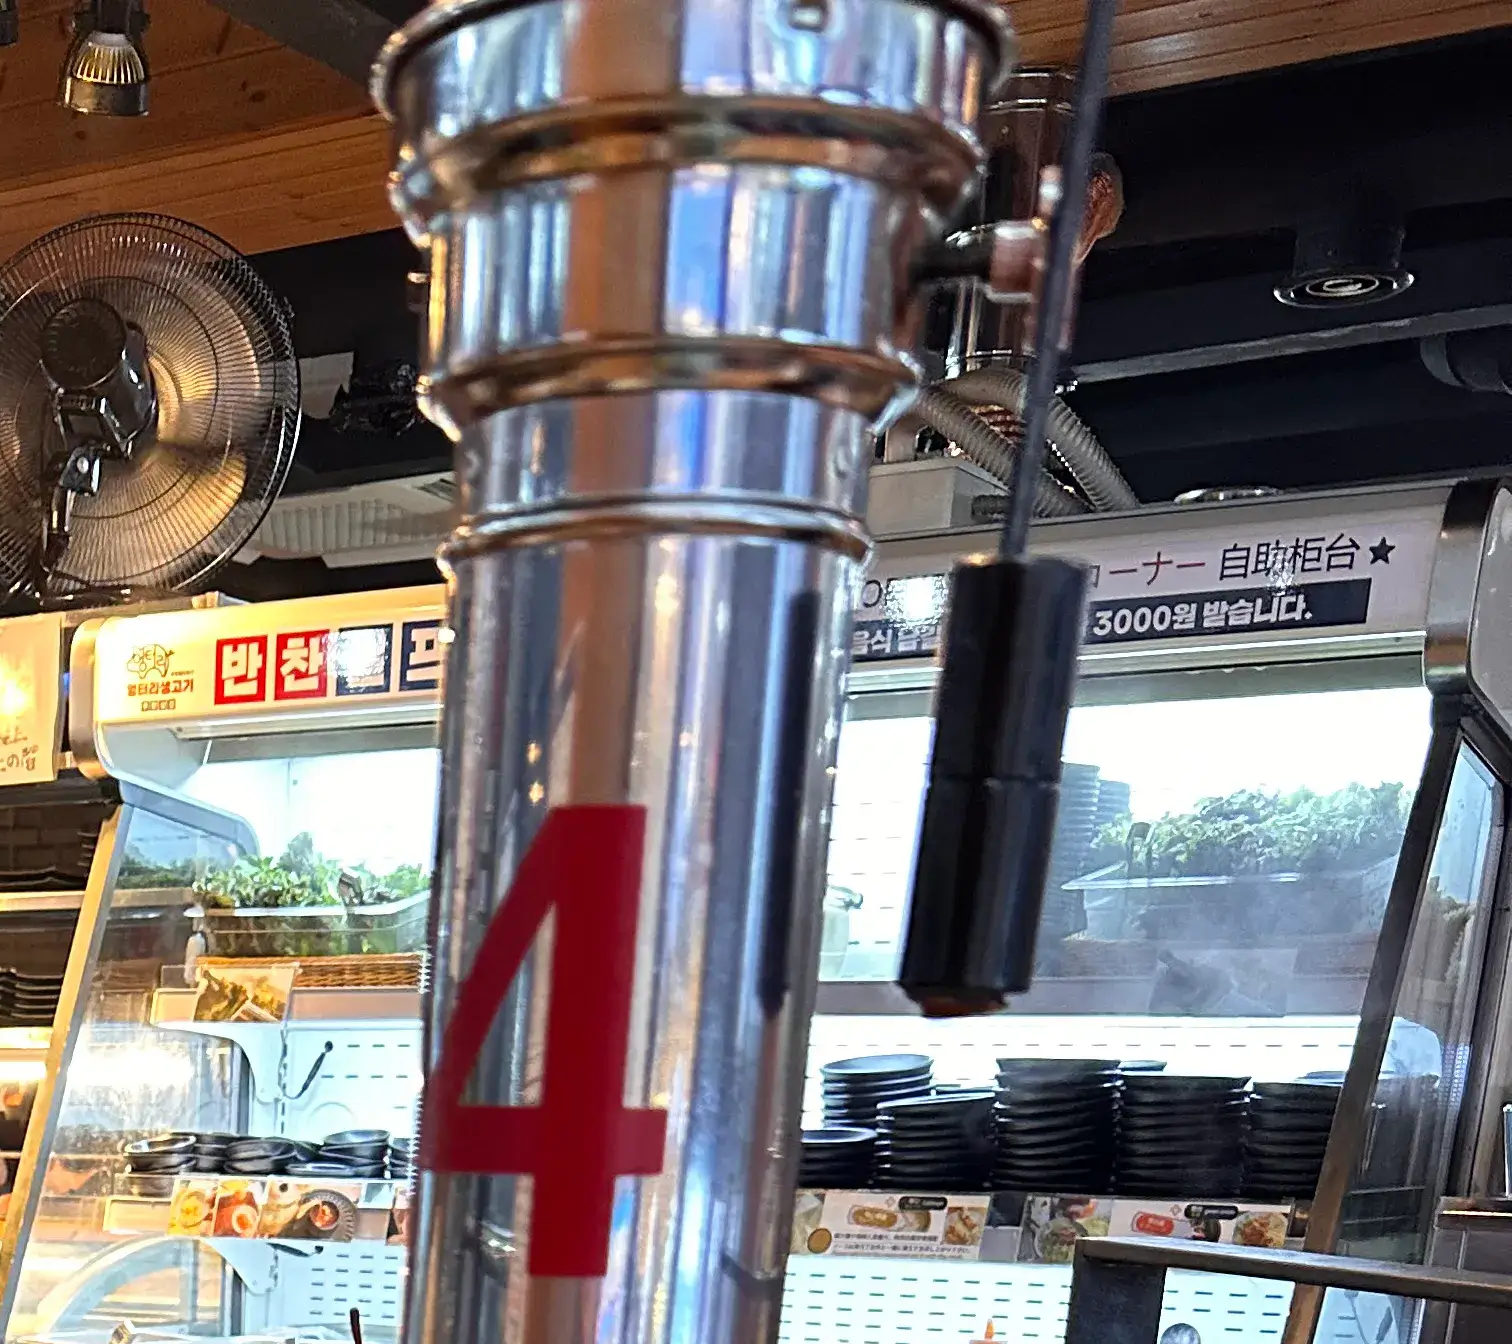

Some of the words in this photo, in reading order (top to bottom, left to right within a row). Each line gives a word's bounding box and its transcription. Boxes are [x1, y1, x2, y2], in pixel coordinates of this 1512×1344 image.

[1092, 601, 1196, 637] 3000원
[1202, 592, 1313, 630] 받습니다.
[419, 804, 668, 1277] 4
